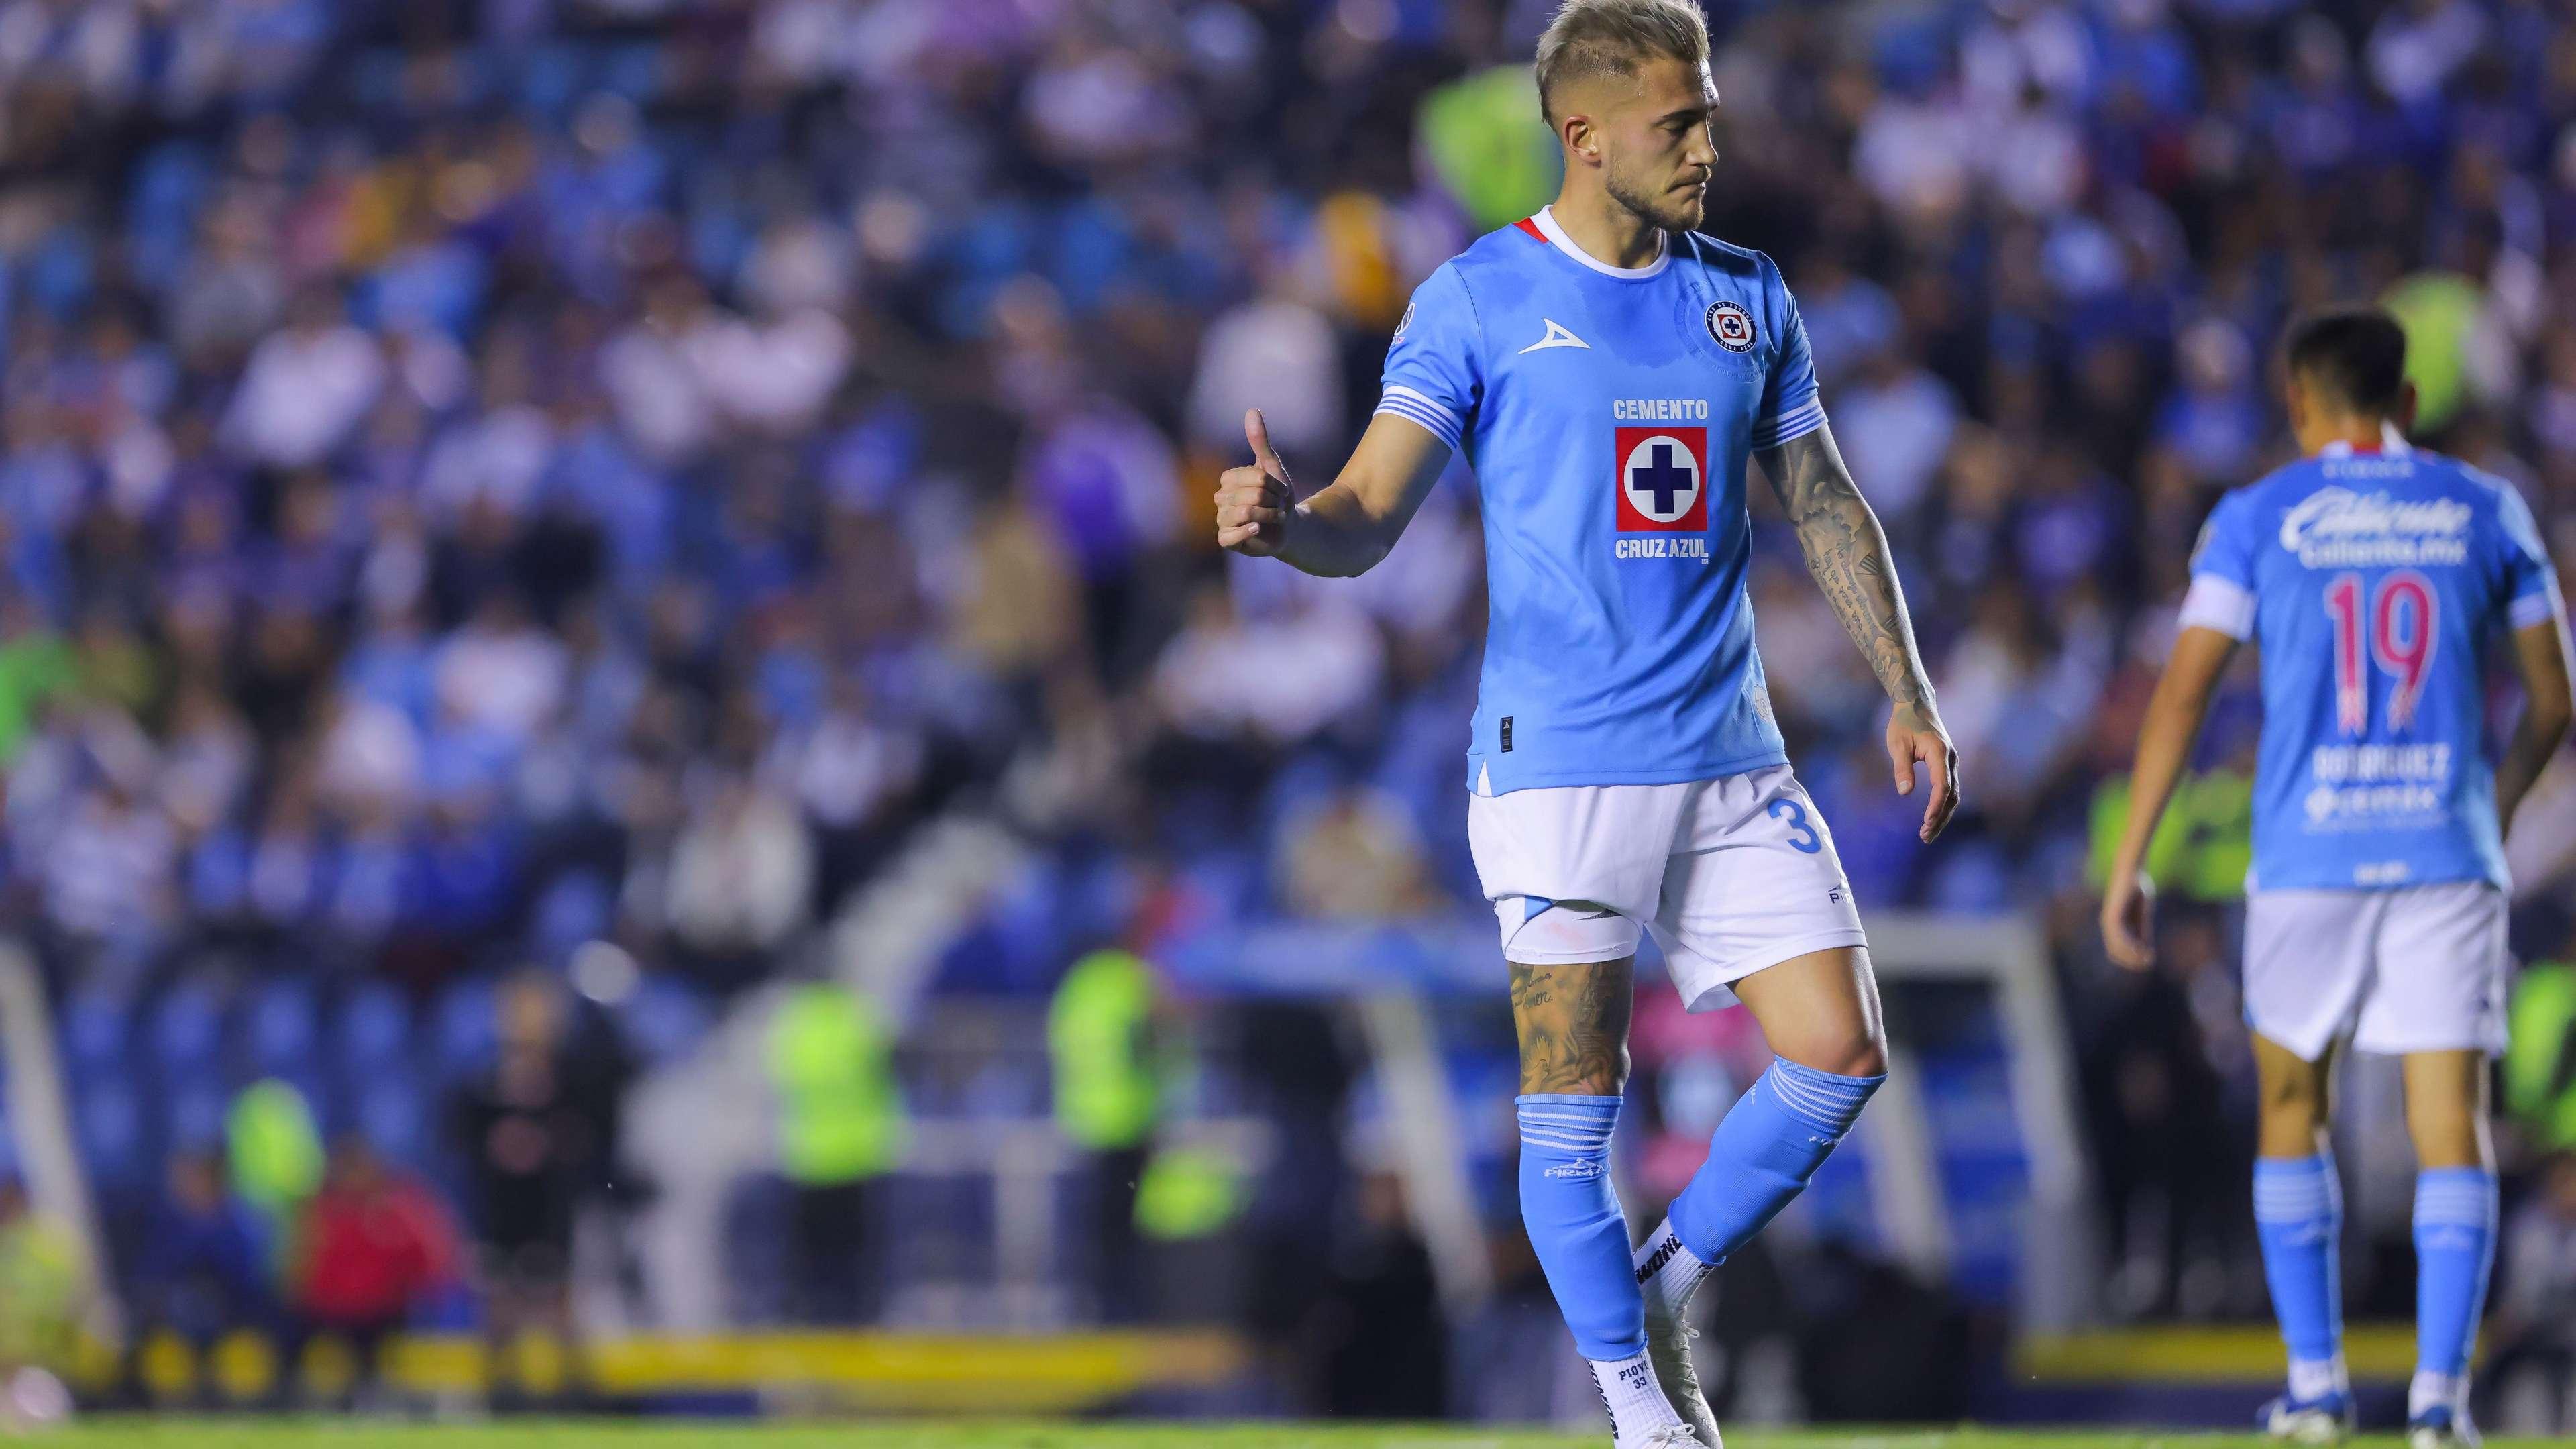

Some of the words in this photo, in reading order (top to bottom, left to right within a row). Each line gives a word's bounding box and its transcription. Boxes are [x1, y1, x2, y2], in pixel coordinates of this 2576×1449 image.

[1719, 340, 1737, 351] CRUZ
[1613, 399, 1708, 419] CEMENTO
[1615, 539, 1666, 559] CRUZ
[1668, 539, 1709, 558] AZUL
[2324, 572, 2438, 735] 19
[1767, 798, 1822, 854] 3
[1619, 1360, 1650, 1381] PIOVI
[1633, 1377, 1648, 1389] 33
